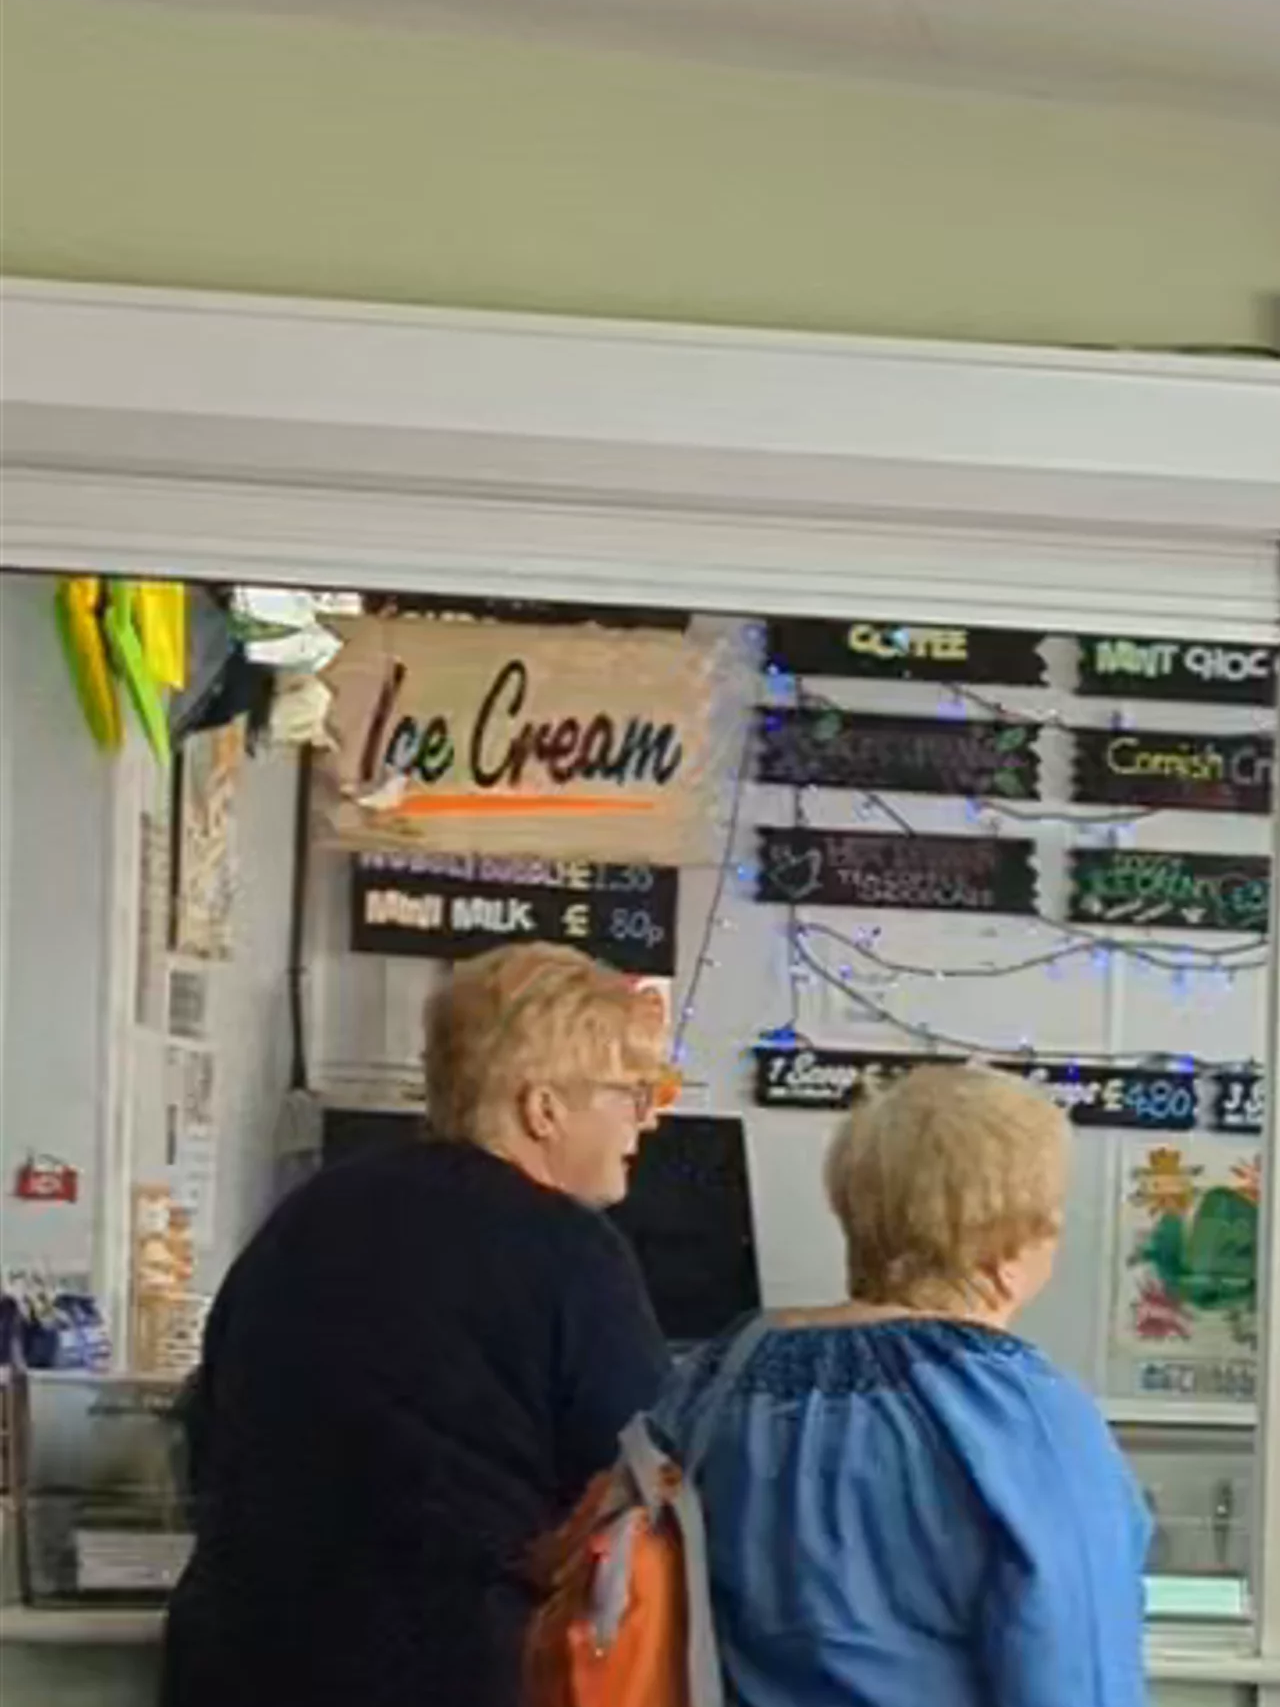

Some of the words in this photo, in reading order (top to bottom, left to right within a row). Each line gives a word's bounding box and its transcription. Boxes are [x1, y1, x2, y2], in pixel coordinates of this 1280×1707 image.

[1184, 646, 1270, 682] CHOC
[361, 662, 455, 783] Ice
[469, 658, 684, 786] Cream
